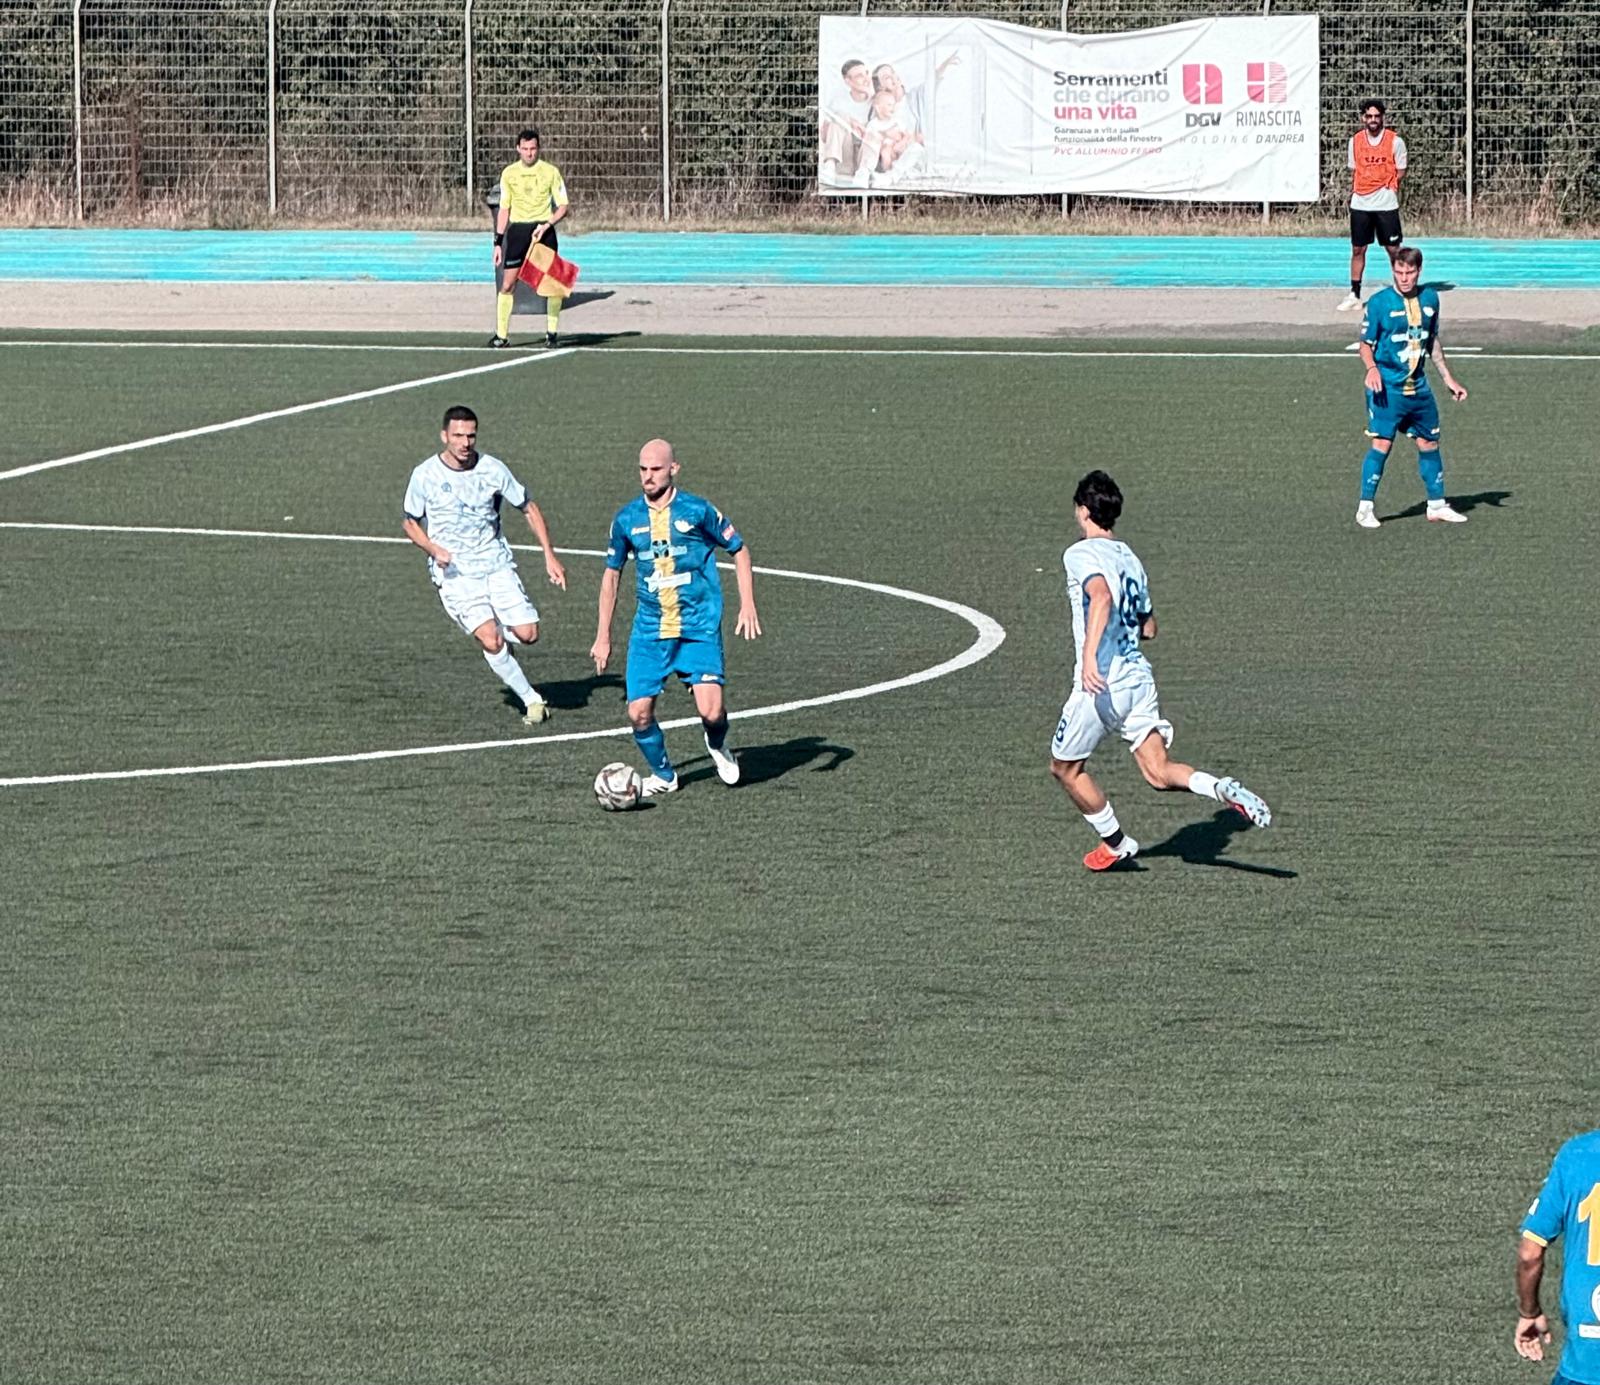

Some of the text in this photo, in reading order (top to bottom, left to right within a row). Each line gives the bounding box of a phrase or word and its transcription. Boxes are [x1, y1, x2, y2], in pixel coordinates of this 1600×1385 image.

[1053, 69, 1168, 86] Serramenti
[1053, 87, 1170, 103] che durano
[1054, 103, 1137, 120] una vita
[1236, 110, 1302, 126] RINASCITA
[1054, 126, 1092, 134] Garanzia
[1101, 126, 1118, 134] vita
[1106, 135, 1127, 143] della
[1130, 135, 1163, 143] finestra
[1179, 135, 1248, 144] HOLDING
[1054, 146, 1073, 155] PVC
[1075, 147, 1128, 155] ALLUMINIO
